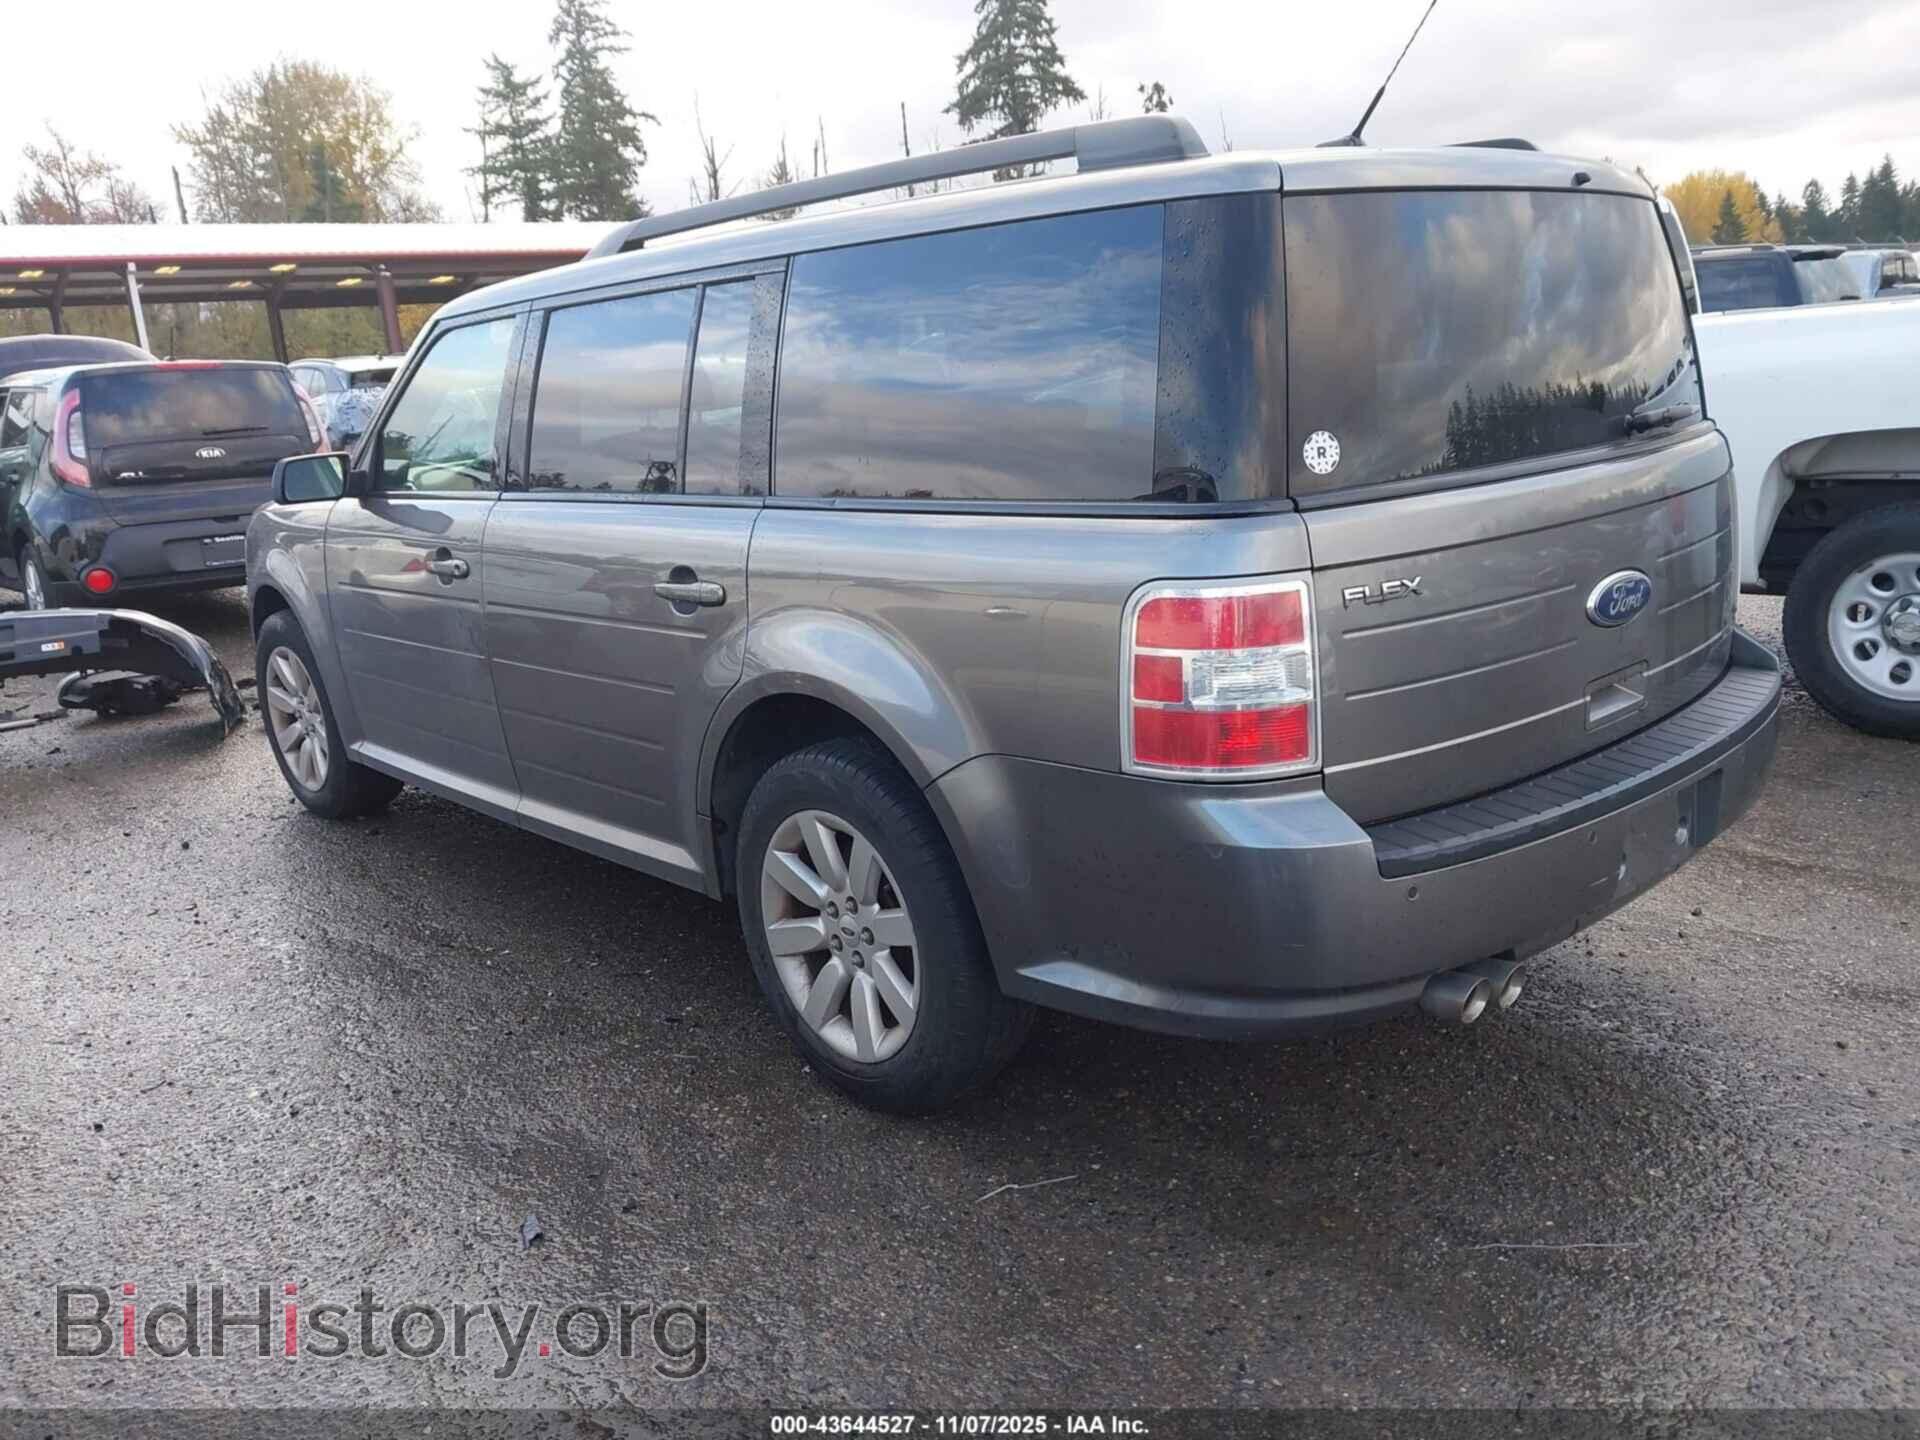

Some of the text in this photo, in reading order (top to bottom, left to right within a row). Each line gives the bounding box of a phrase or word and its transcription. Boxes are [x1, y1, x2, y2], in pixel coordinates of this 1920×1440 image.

[1316, 446, 1327, 459] R
[1343, 576, 1424, 610] FLEX
[1609, 580, 1644, 616] Ford
